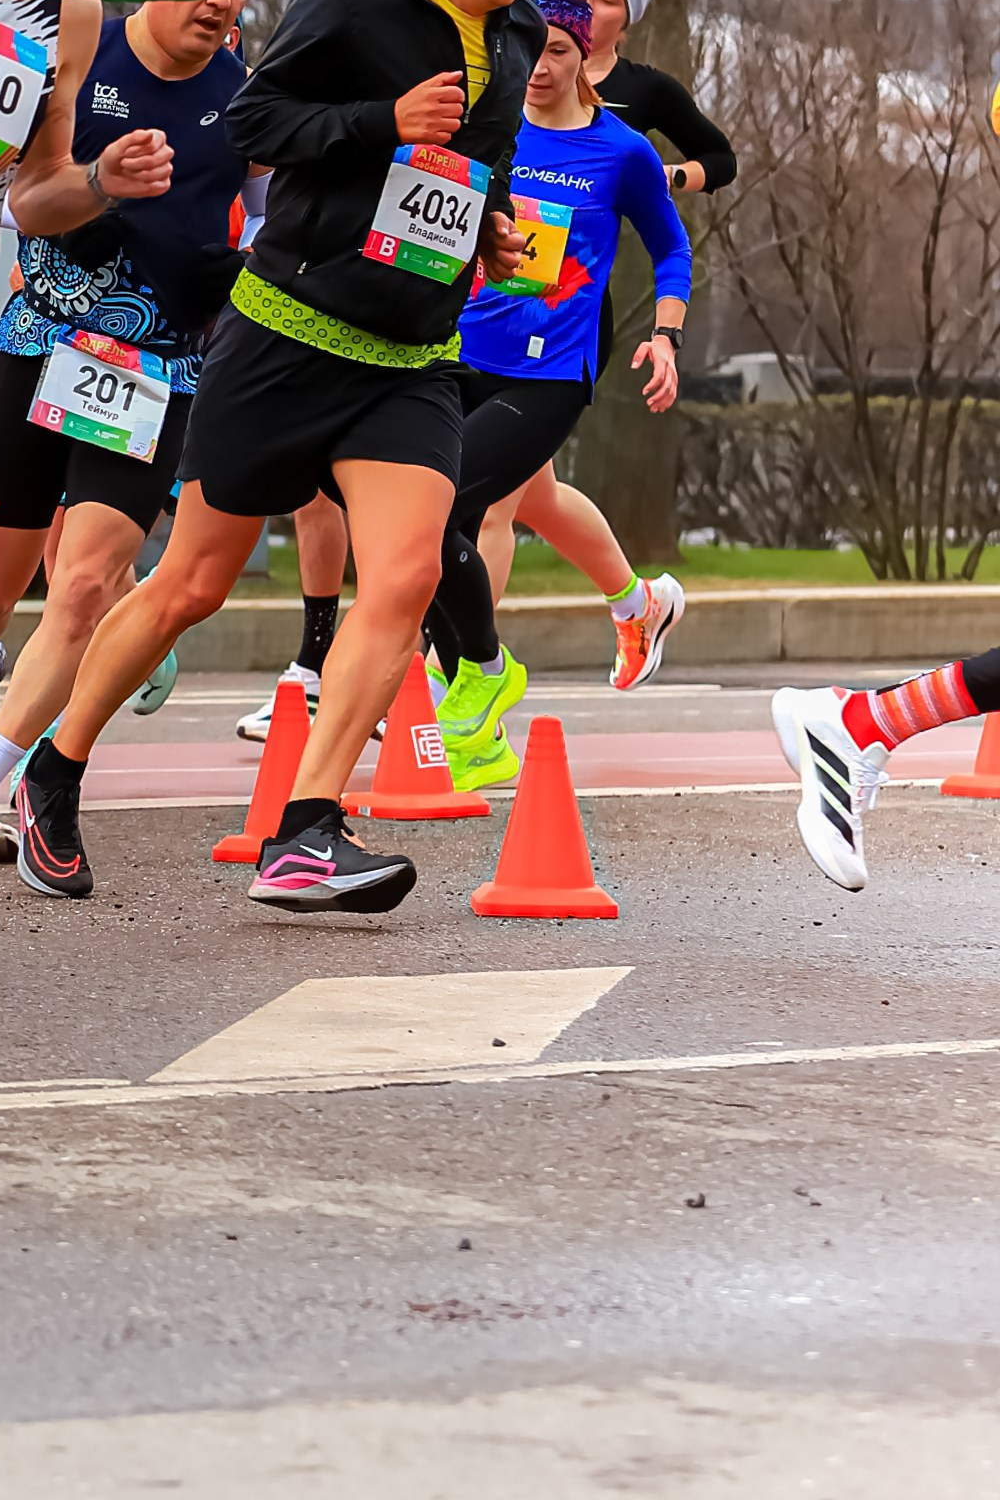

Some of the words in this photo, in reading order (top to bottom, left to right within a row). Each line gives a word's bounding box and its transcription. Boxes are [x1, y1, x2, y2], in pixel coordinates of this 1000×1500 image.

[92, 97, 118, 106] SYDNEY
[93, 81, 119, 100] tcs
[92, 103, 130, 115] MARATHON
[417, 147, 461, 172] АПРЕЛЬ
[398, 183, 473, 237] 4034
[408, 222, 457, 249] Владислав
[78, 336, 128, 358] АПРЕЛЬ
[72, 365, 138, 412] 201
[81, 400, 120, 421] Теймур
